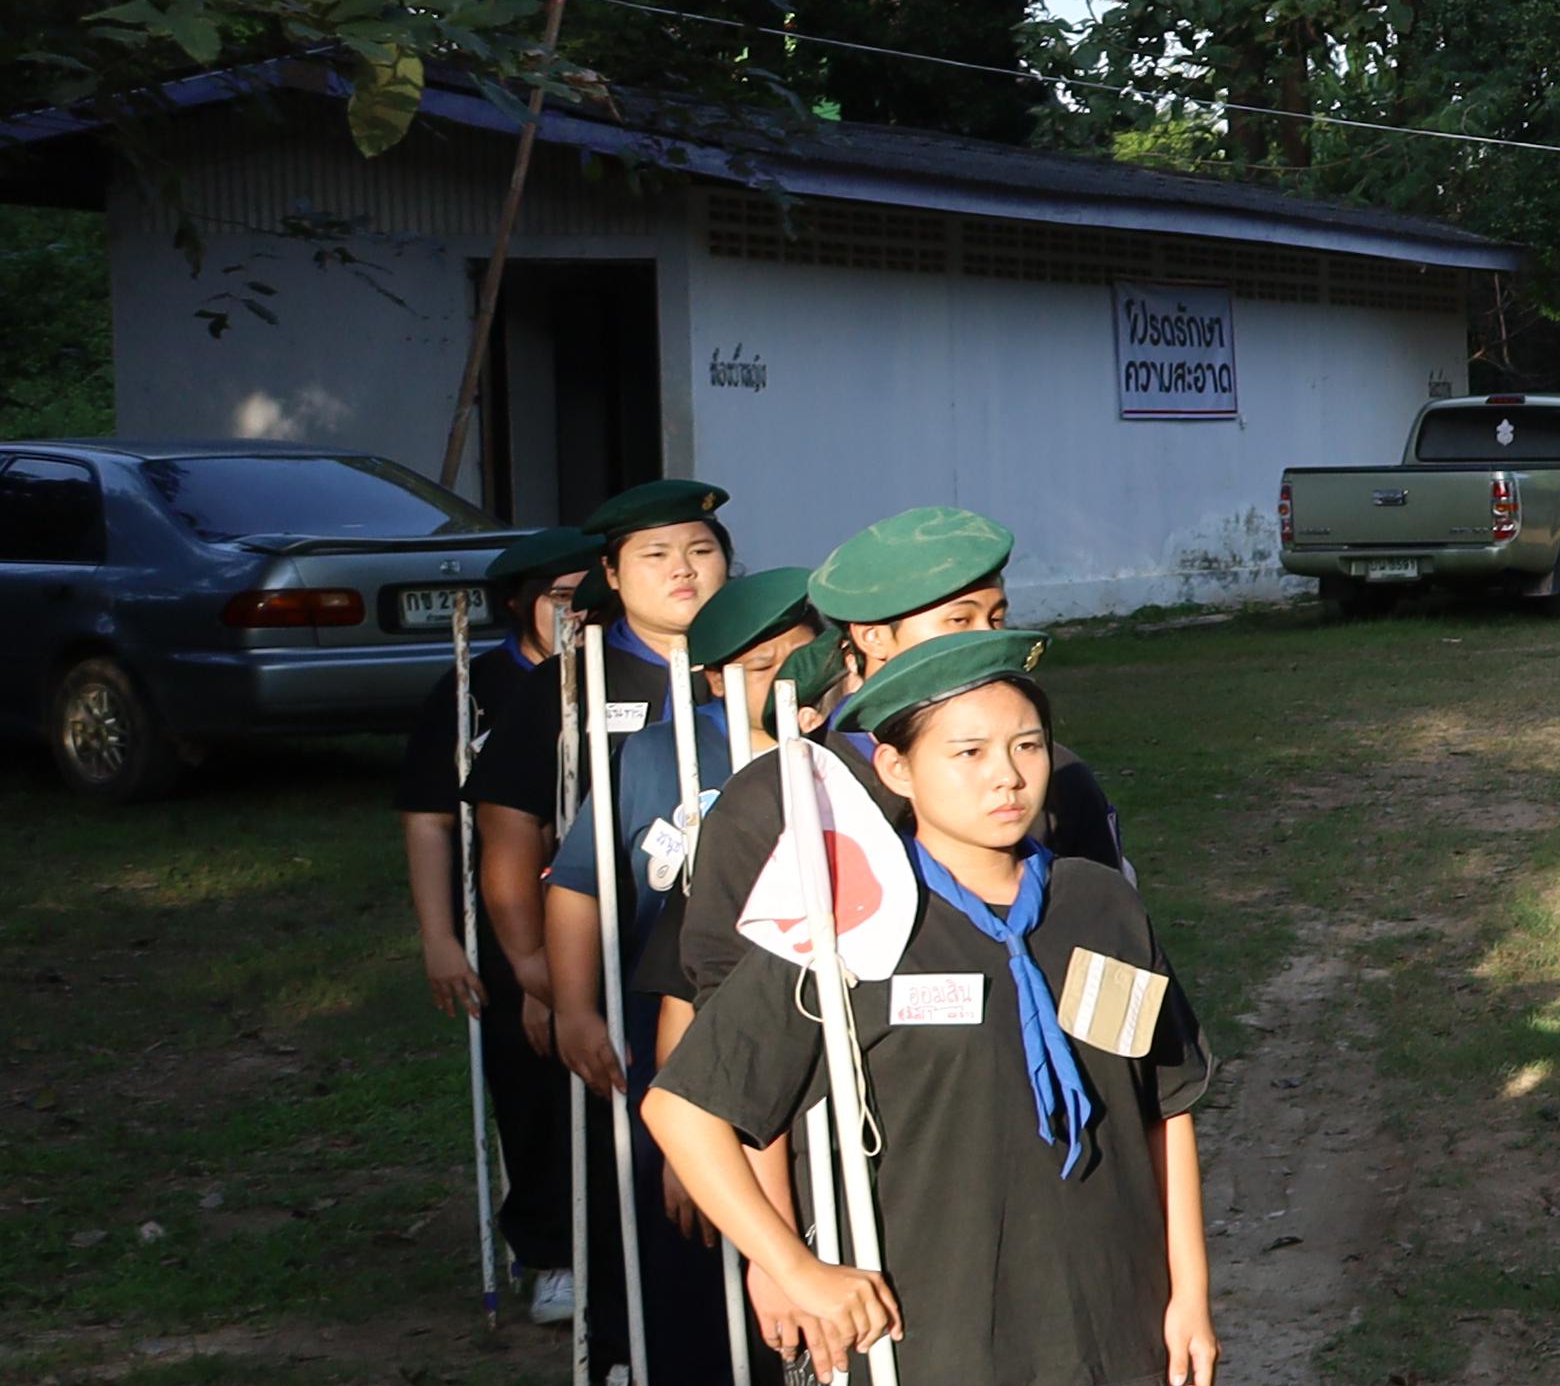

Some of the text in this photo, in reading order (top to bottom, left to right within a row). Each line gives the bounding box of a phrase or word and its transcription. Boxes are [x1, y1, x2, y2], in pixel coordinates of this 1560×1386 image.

[1125, 298, 1225, 348] โปรดรักษา
[1125, 360, 1232, 393] ความสะอาด
[908, 979, 973, 1006] ออมสิน
